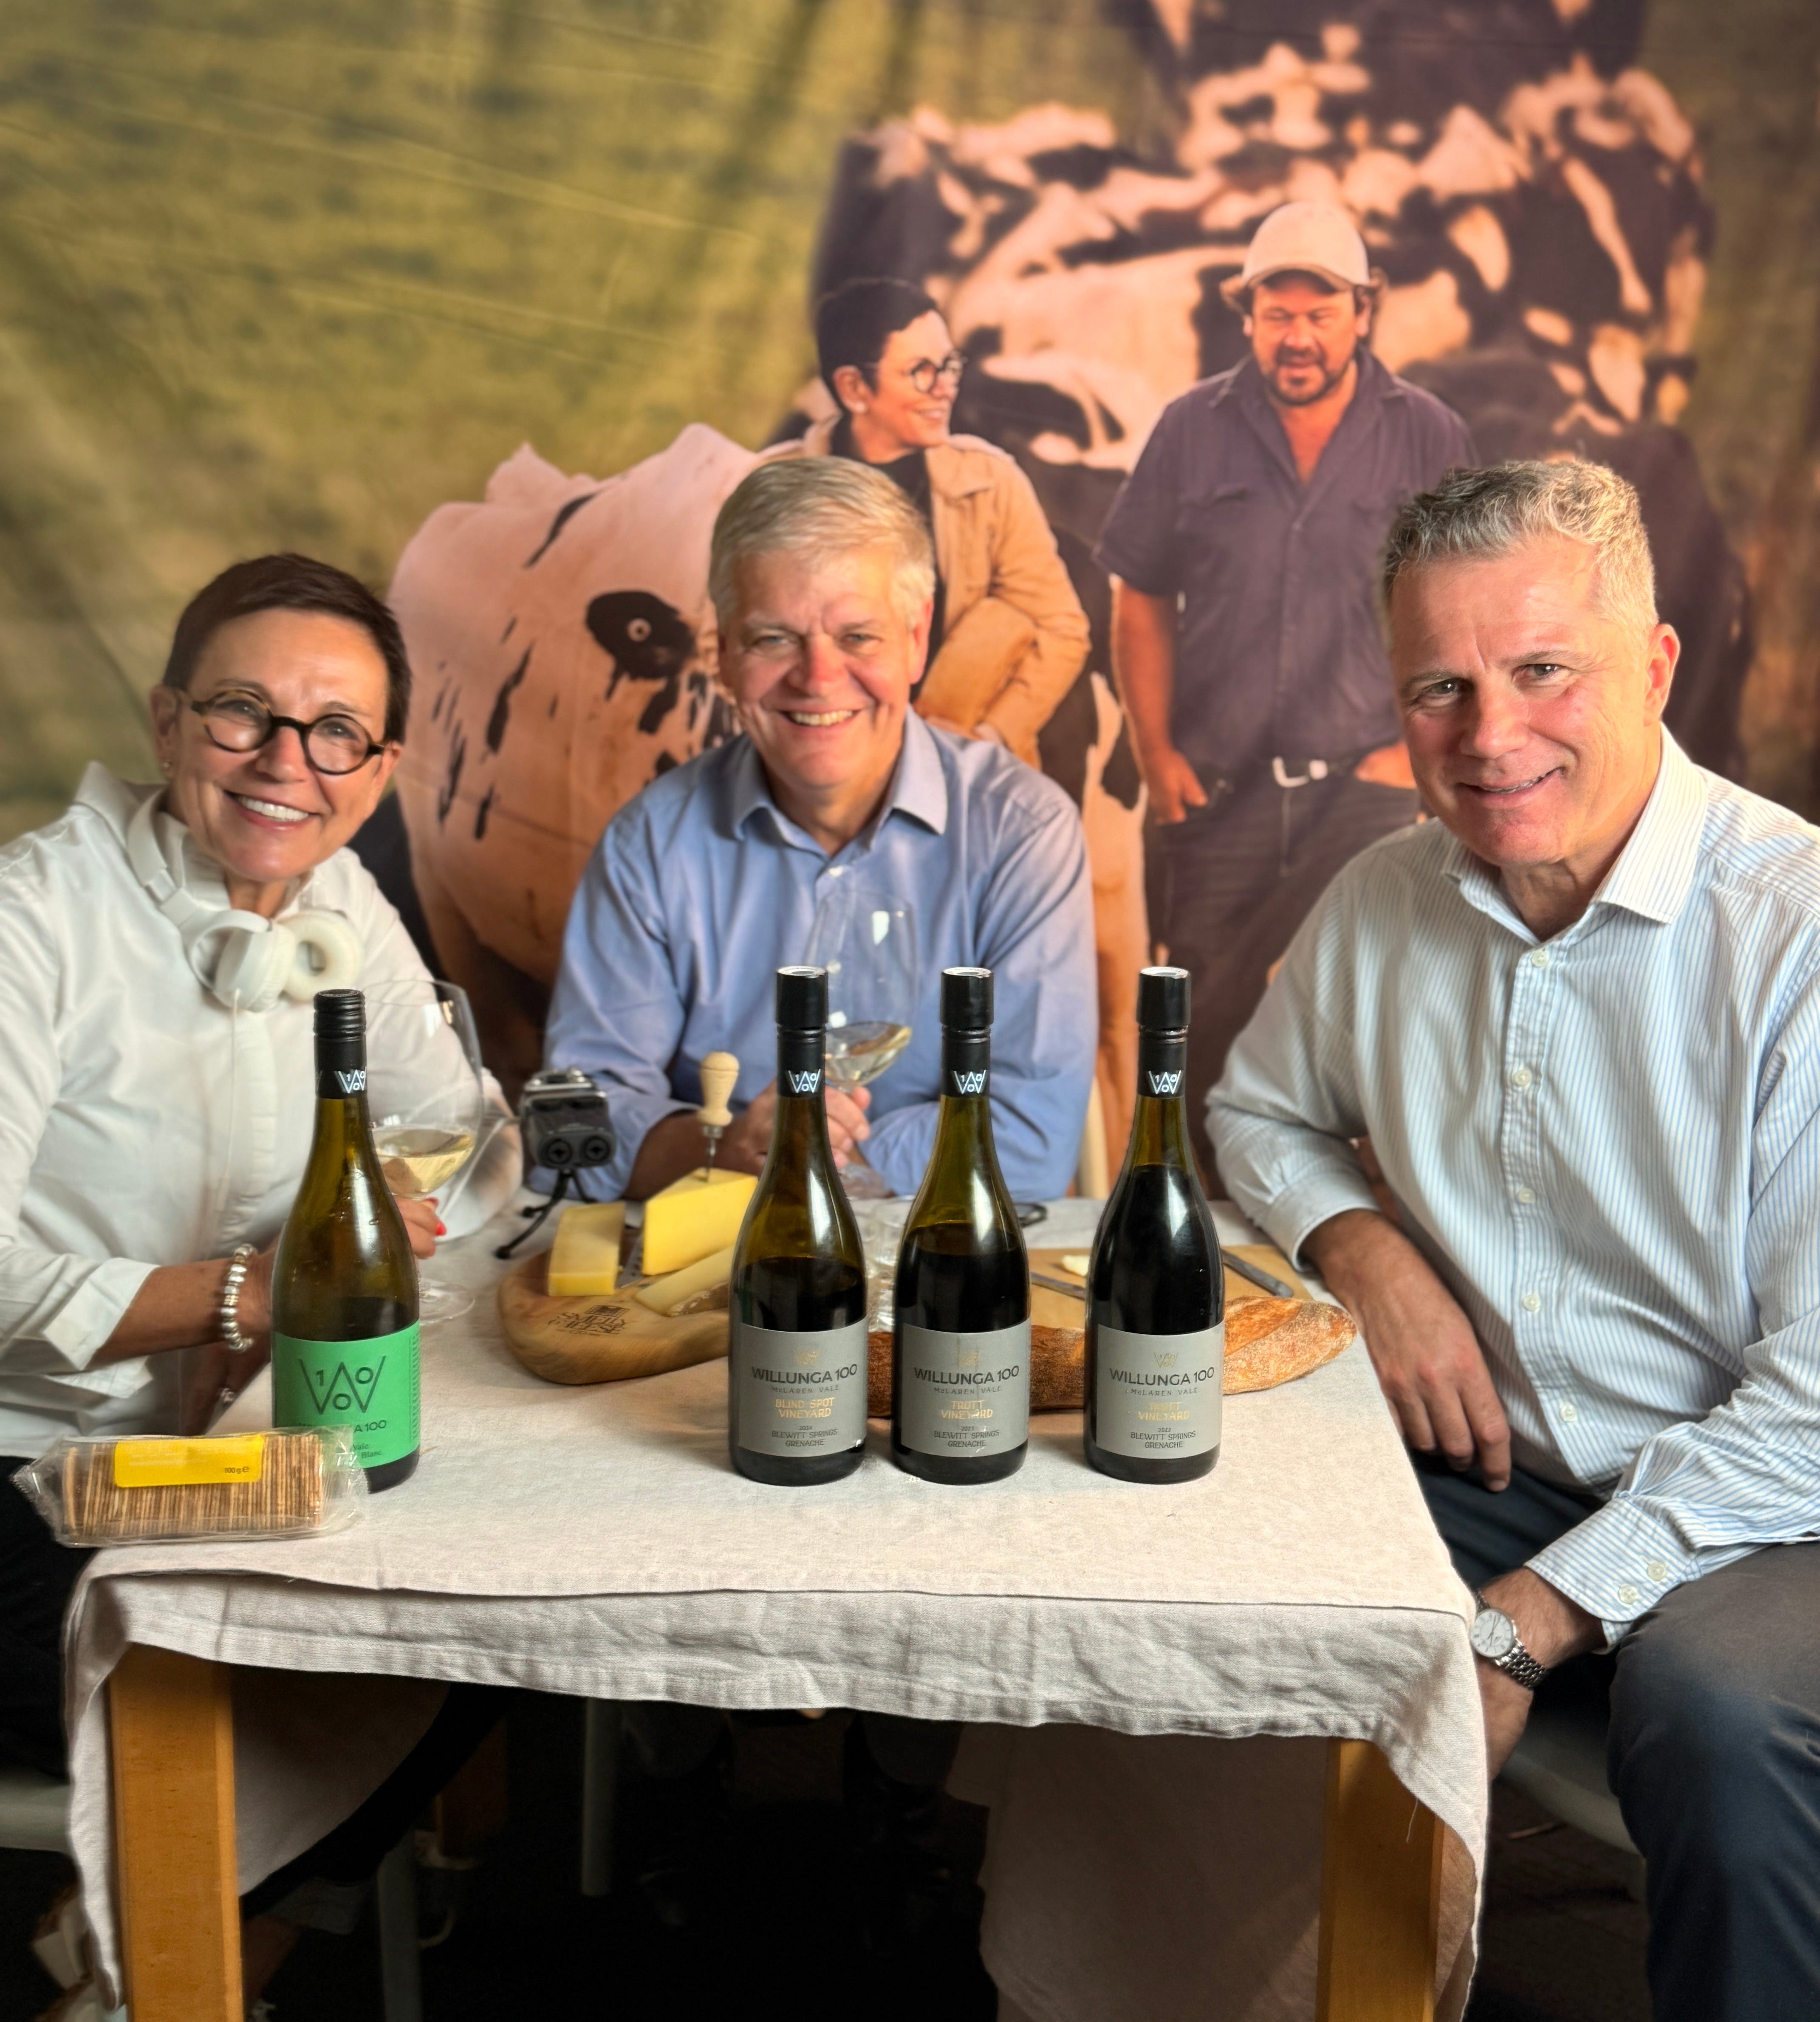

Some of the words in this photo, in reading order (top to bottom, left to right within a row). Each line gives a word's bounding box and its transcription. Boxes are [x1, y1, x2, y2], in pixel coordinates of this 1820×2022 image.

[752, 1365, 832, 1384] WILLUNGA
[835, 1364, 857, 1381] 100
[914, 1367, 995, 1385] WILLUNGA
[997, 1365, 1019, 1382] 100
[1110, 1367, 1191, 1386] WILLUNGA
[1194, 1367, 1215, 1384] 100
[819, 1384, 840, 1393] VALE
[981, 1385, 1002, 1394] VALE
[1178, 1387, 1198, 1395] VALE
[775, 1399, 804, 1409] BLIND
[810, 1397, 834, 1408] SPOT
[778, 1408, 831, 1419] VINEYARD
[940, 1409, 993, 1420] VINEYARD
[365, 1420, 387, 1432] 100
[772, 1430, 806, 1438] BLEWITT
[809, 1428, 838, 1438] SPRINGS
[934, 1430, 967, 1439] BLEWITT
[971, 1429, 1000, 1439] SPRINGS
[1130, 1432, 1166, 1440] BLEWITT
[786, 1439, 825, 1447] GRENACHE
[948, 1439, 986, 1448] GRENACHE
[1145, 1440, 1183, 1449] GRENACHE
